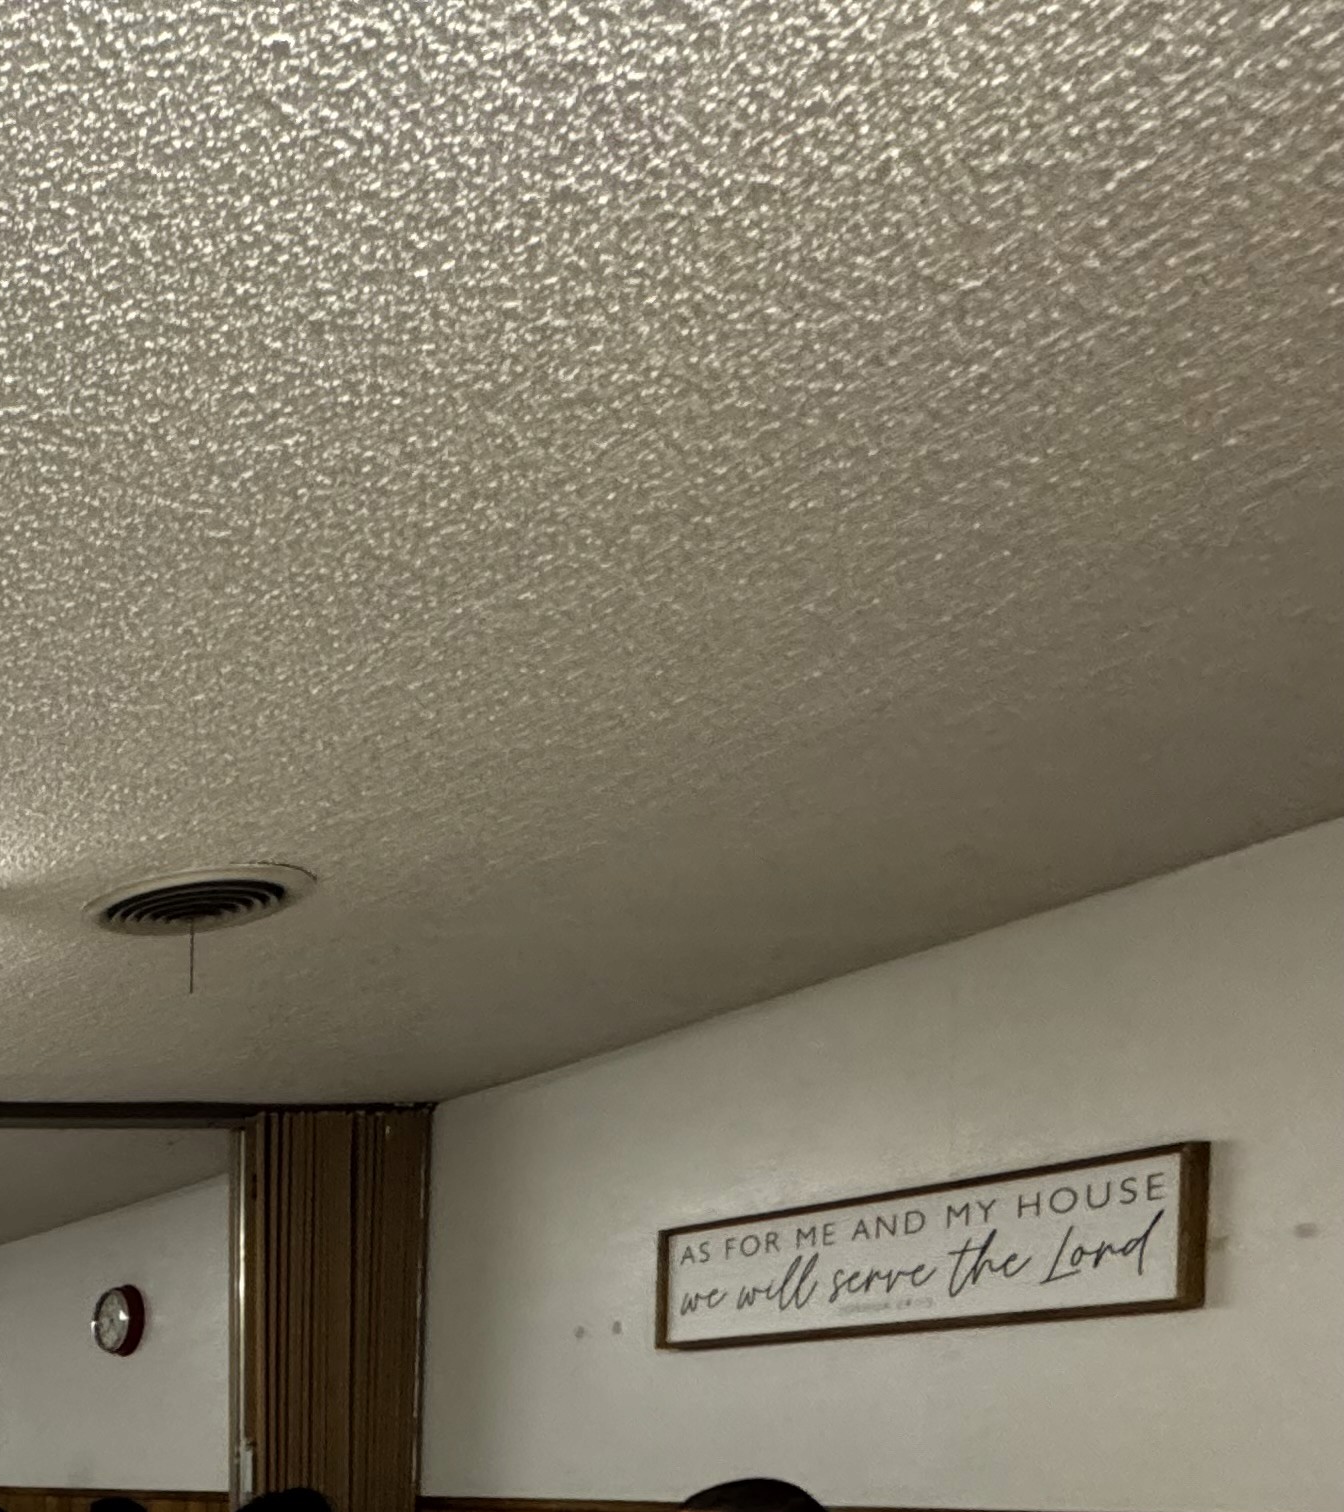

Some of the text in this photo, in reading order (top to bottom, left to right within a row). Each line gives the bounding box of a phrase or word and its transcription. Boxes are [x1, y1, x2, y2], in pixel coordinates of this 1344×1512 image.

[680, 1172, 1165, 1265] AS FOR ME AND MY HOUSE
[680, 1208, 1165, 1316] we will serve the Lord
